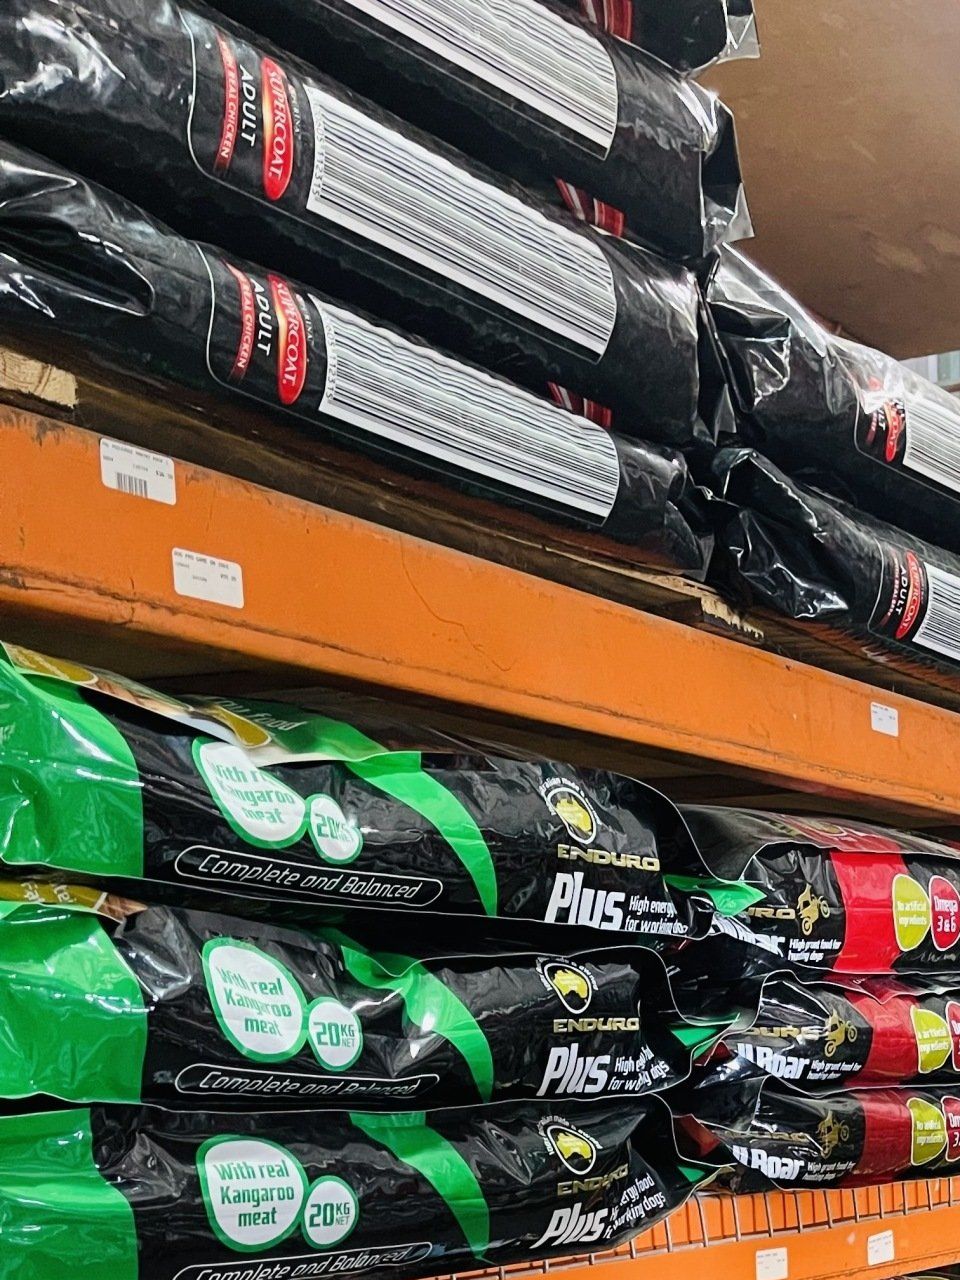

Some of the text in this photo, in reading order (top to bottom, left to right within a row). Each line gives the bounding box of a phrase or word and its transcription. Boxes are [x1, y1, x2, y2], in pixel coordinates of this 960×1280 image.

[239, 63, 257, 148] ADULT
[220, 101, 238, 159] CHICKEN
[266, 68, 287, 181] SUPERCOAT
[248, 277, 273, 357] ADULT
[236, 311, 256, 369] CHICKEN
[272, 280, 301, 388] SUPERCOAT
[895, 564, 908, 616] ADULT
[243, 806, 286, 825] meat
[557, 843, 661, 872] ENDURO
[198, 852, 423, 900] Complete and Balanced
[544, 871, 626, 931] Plus
[628, 895, 652, 915] High
[933, 897, 959, 916] Omega
[625, 915, 638, 932] for
[215, 966, 284, 997] With real
[222, 986, 293, 1018] Kangaroo
[243, 1016, 284, 1038] meat
[553, 1016, 640, 1034] ENDURO
[535, 1042, 612, 1097] Plus
[614, 1056, 635, 1076] High
[755, 1045, 811, 1080] Roar
[199, 1070, 301, 1094] Complete
[298, 1076, 345, 1096] and
[607, 1075, 625, 1092] for
[213, 1159, 290, 1182] With real
[750, 1147, 805, 1181] Roar
[219, 1184, 295, 1208] Kangaroo
[636, 1171, 656, 1193] food
[643, 1189, 667, 1212] dogs
[237, 1206, 278, 1228] meat
[334, 1215, 351, 1227] NET
[528, 1202, 609, 1250] Plus
